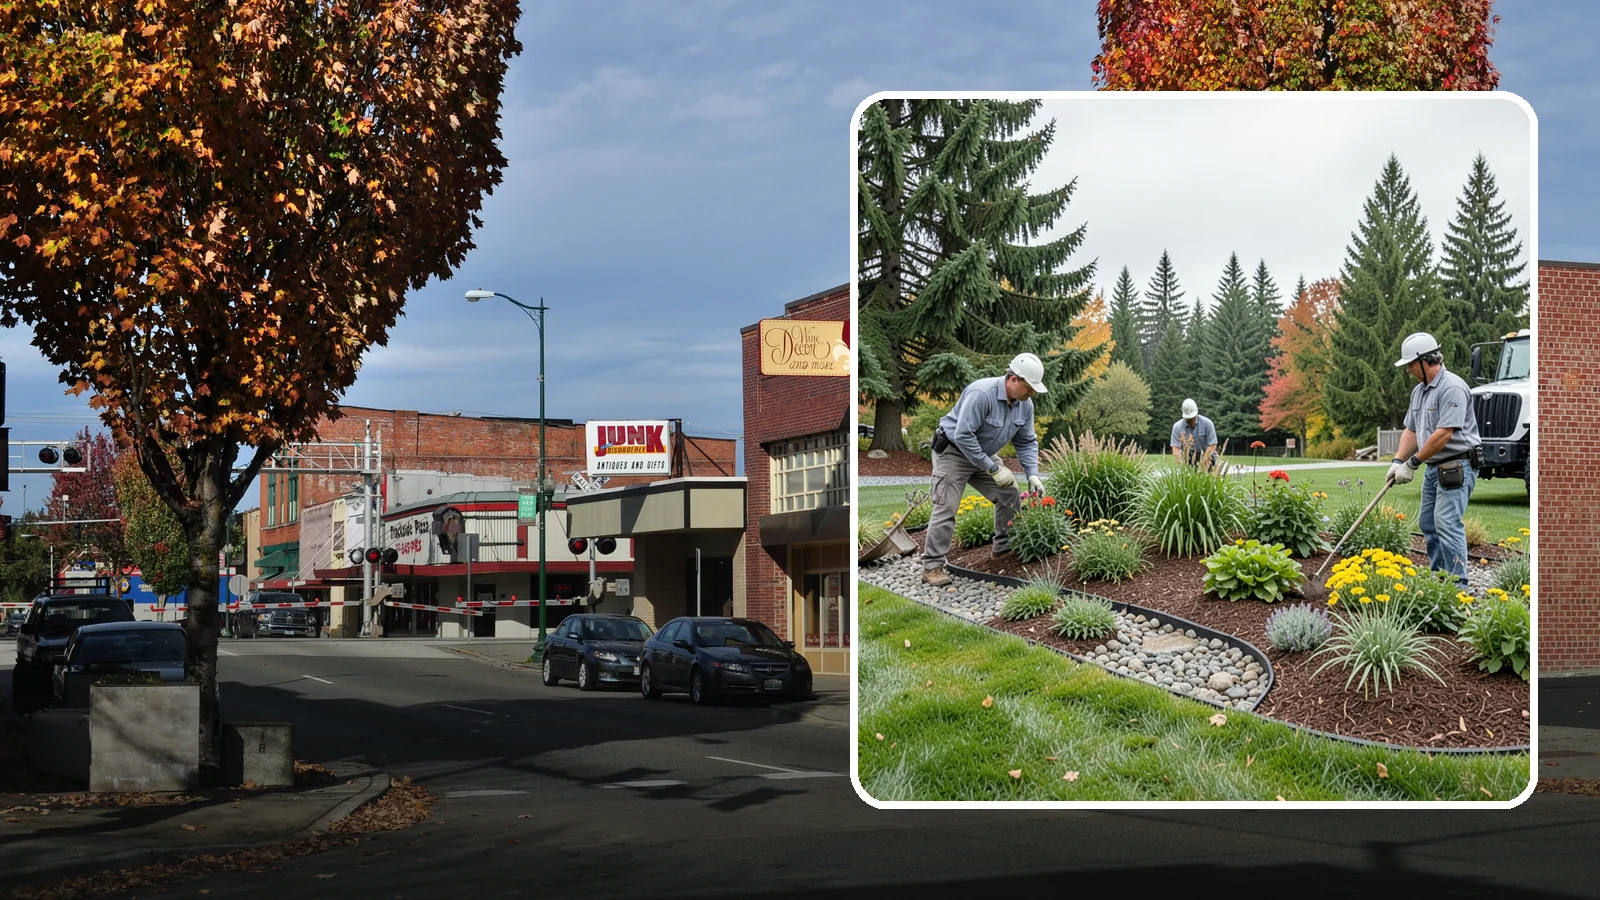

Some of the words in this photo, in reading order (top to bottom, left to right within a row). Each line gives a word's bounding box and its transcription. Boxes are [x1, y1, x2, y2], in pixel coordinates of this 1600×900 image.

[596, 426, 665, 457] JUNK
[597, 461, 628, 470] ANTIQUES
[631, 462, 644, 470] AND
[647, 460, 665, 469] GIFTS
[574, 473, 588, 492] RAIL
[590, 476, 608, 492] SING
[390, 521, 412, 540] Trackside
[414, 520, 429, 534] Pizza
